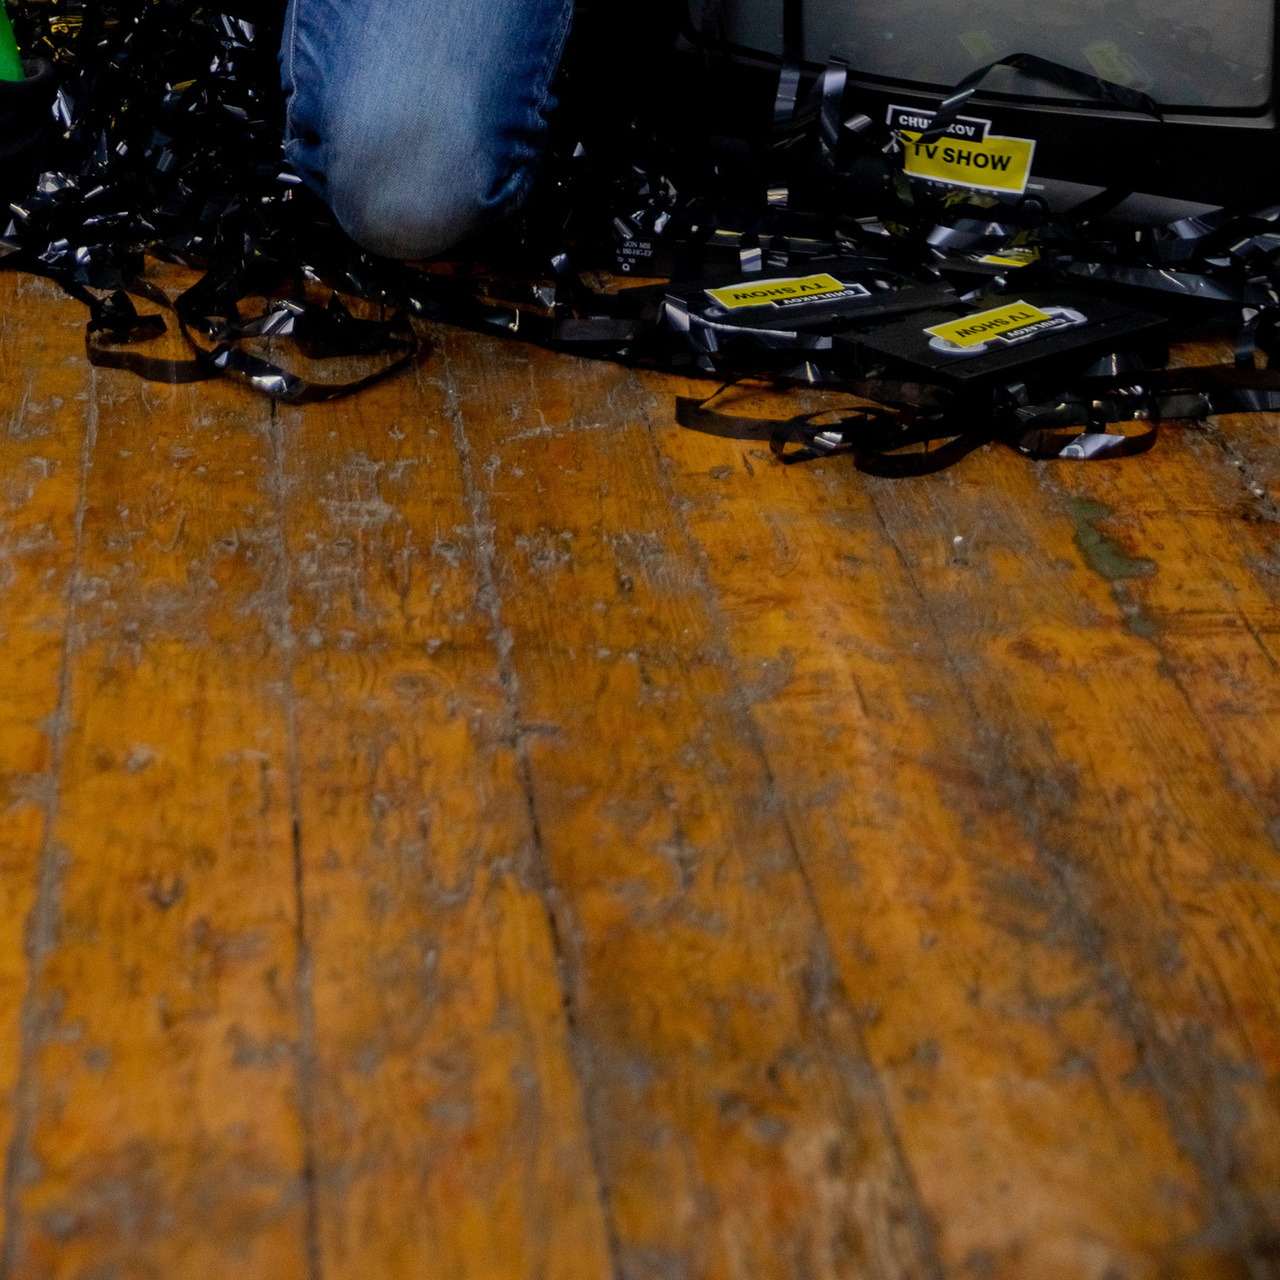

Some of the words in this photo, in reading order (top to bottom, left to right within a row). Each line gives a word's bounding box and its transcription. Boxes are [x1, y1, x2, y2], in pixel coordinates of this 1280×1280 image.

[898, 114, 976, 137] CHUKOV
[914, 143, 939, 159] TV
[943, 148, 1011, 171] SHOW
[733, 287, 796, 300] SHOW
[800, 282, 827, 291] TV
[783, 289, 856, 305] CHULAKOV
[1010, 311, 1035, 322] TV
[955, 318, 1010, 338] SHOW
[1006, 318, 1067, 338] CHULAKOV
